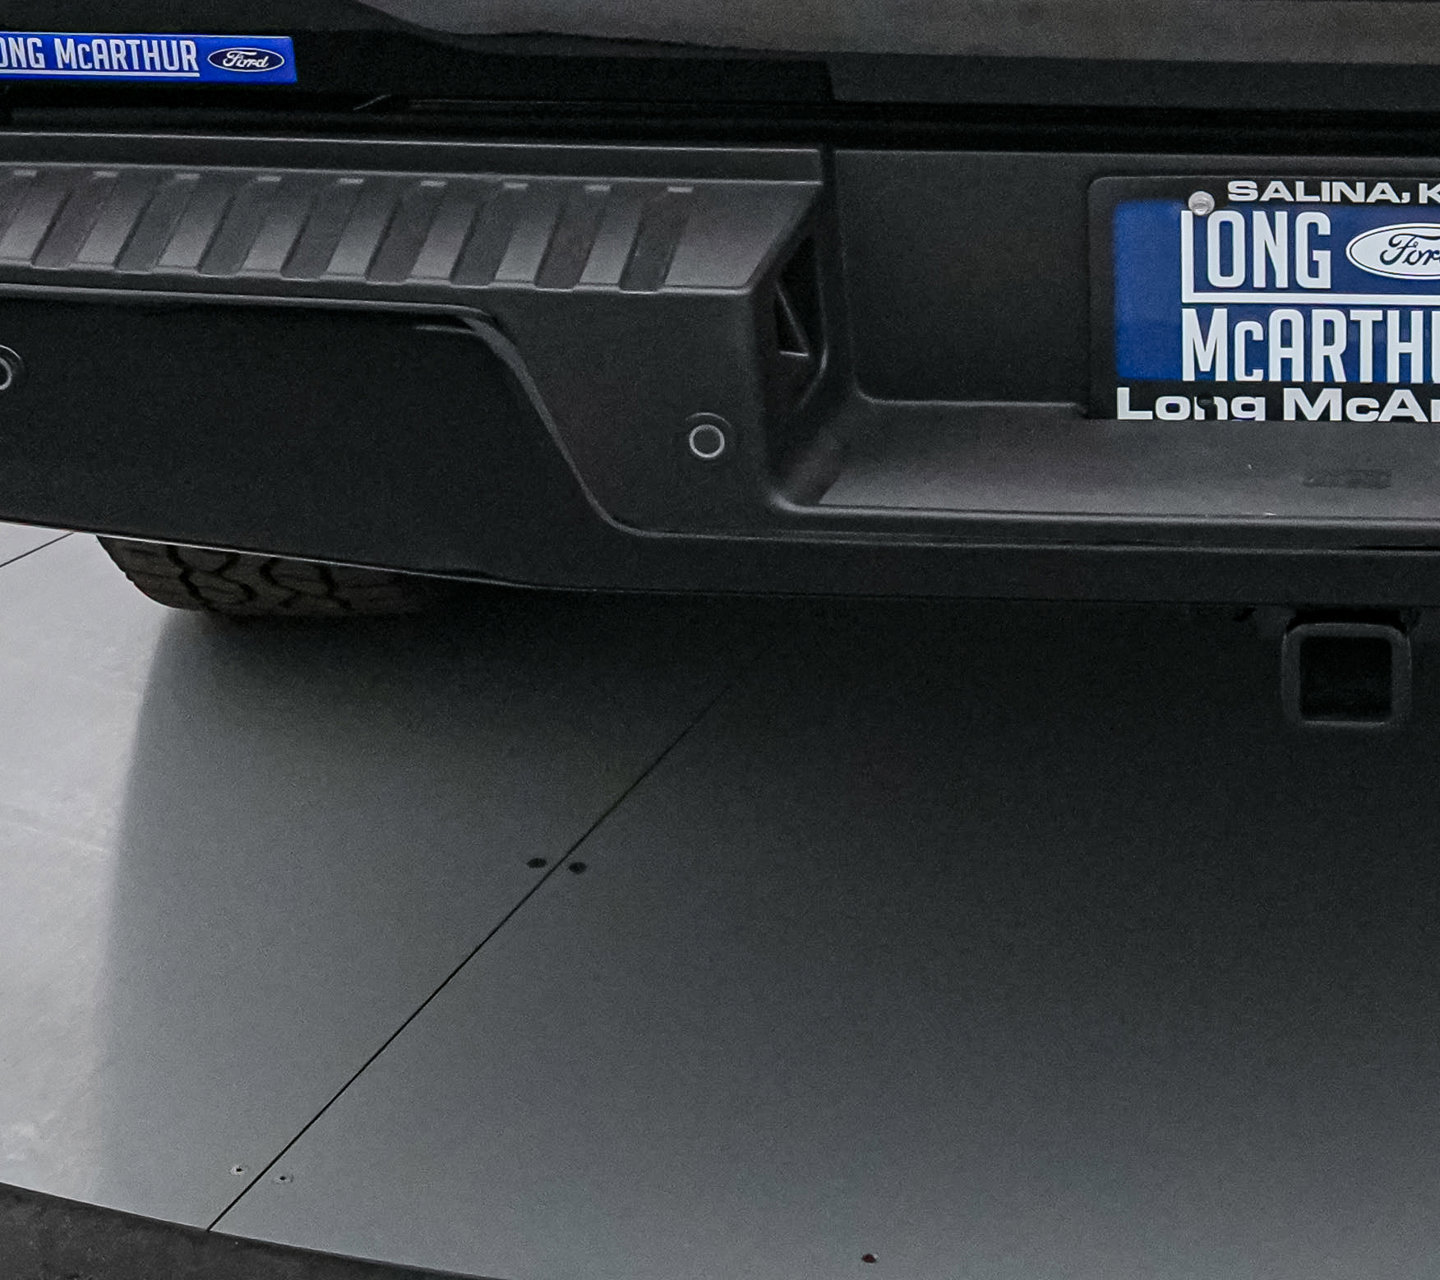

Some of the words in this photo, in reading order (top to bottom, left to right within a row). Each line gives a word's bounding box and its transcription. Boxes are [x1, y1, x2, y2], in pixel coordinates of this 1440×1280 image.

[54, 38, 200, 72] McARTHUR
[1227, 180, 1411, 204] SALINA,
[1181, 209, 1332, 296] LONG
[1116, 386, 1266, 422] Long
